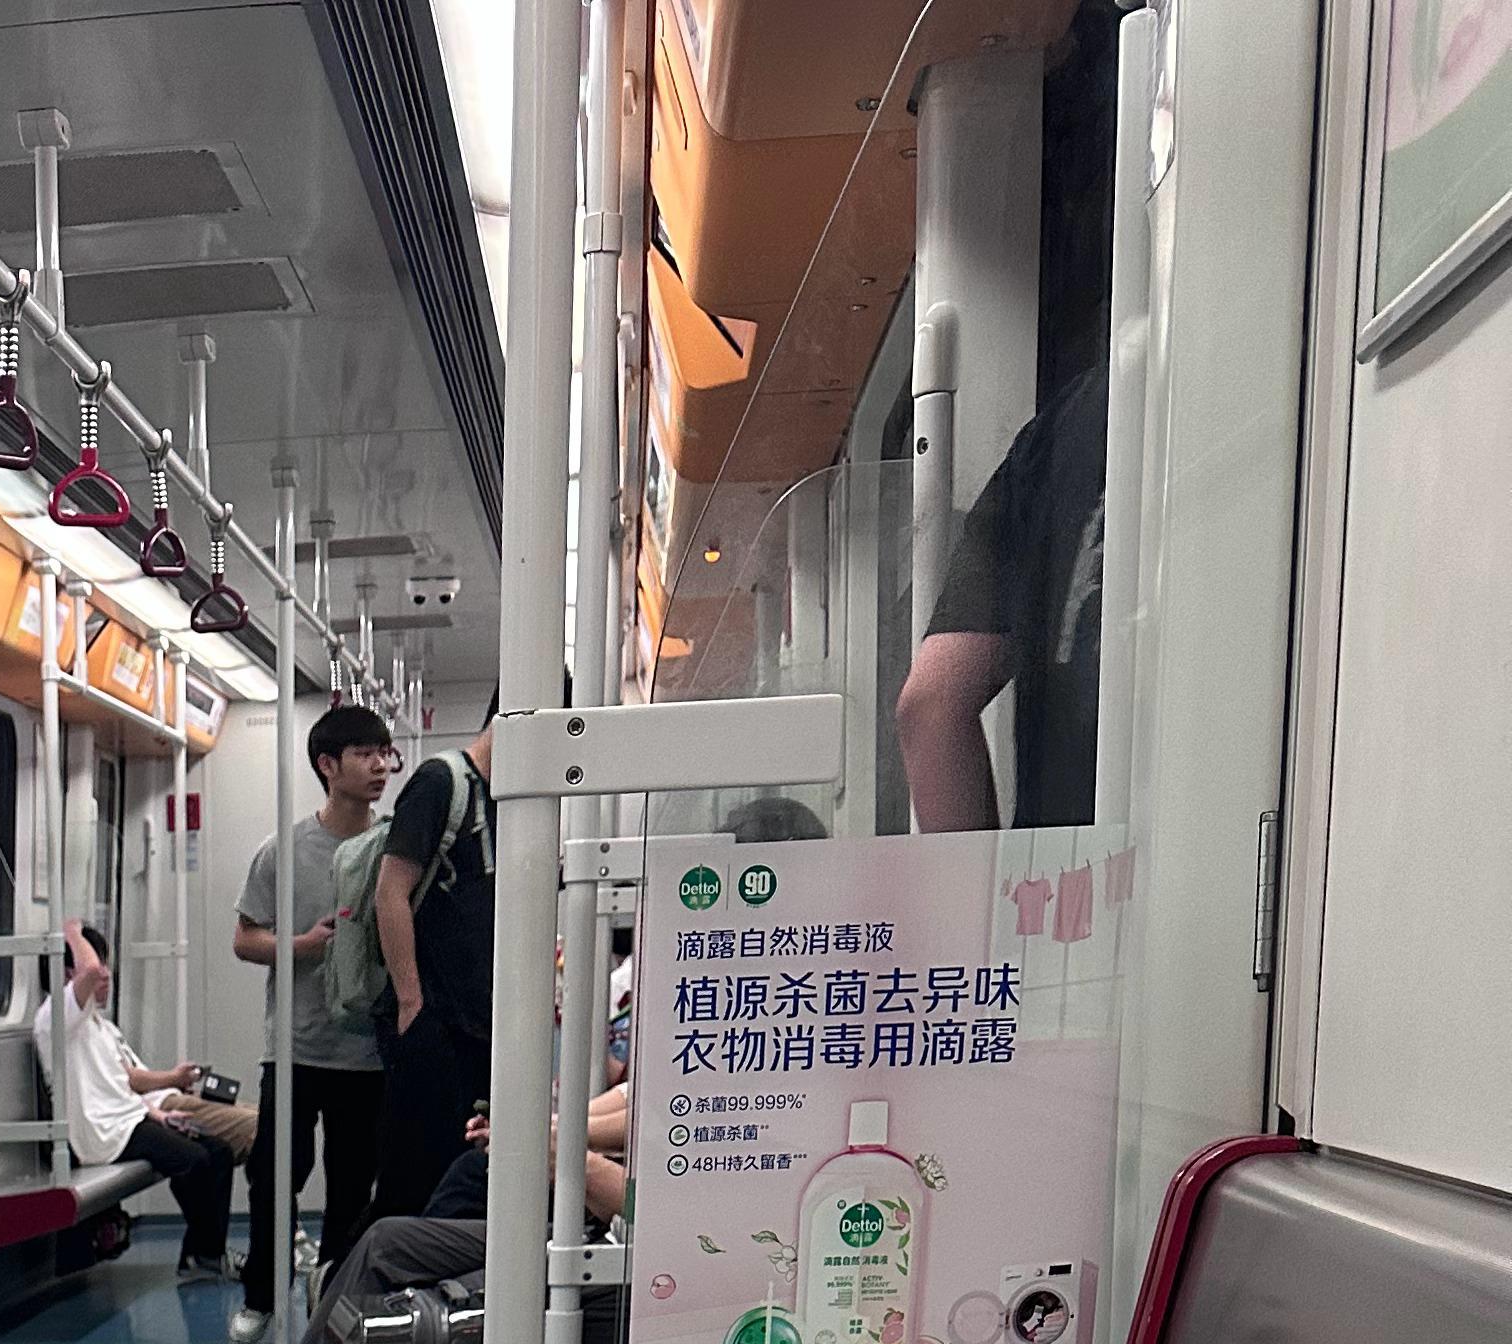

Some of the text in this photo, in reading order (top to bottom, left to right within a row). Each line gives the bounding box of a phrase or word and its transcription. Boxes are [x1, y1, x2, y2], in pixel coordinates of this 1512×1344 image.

[681, 881, 719, 896] Dettol
[744, 871, 771, 895] 90
[676, 921, 895, 962] 滴露自然消毒液
[673, 962, 1020, 1024] 植源杀菌去异味
[672, 1017, 1017, 1075] 衣物消毒用滴露
[841, 1218, 882, 1232] Dettol
